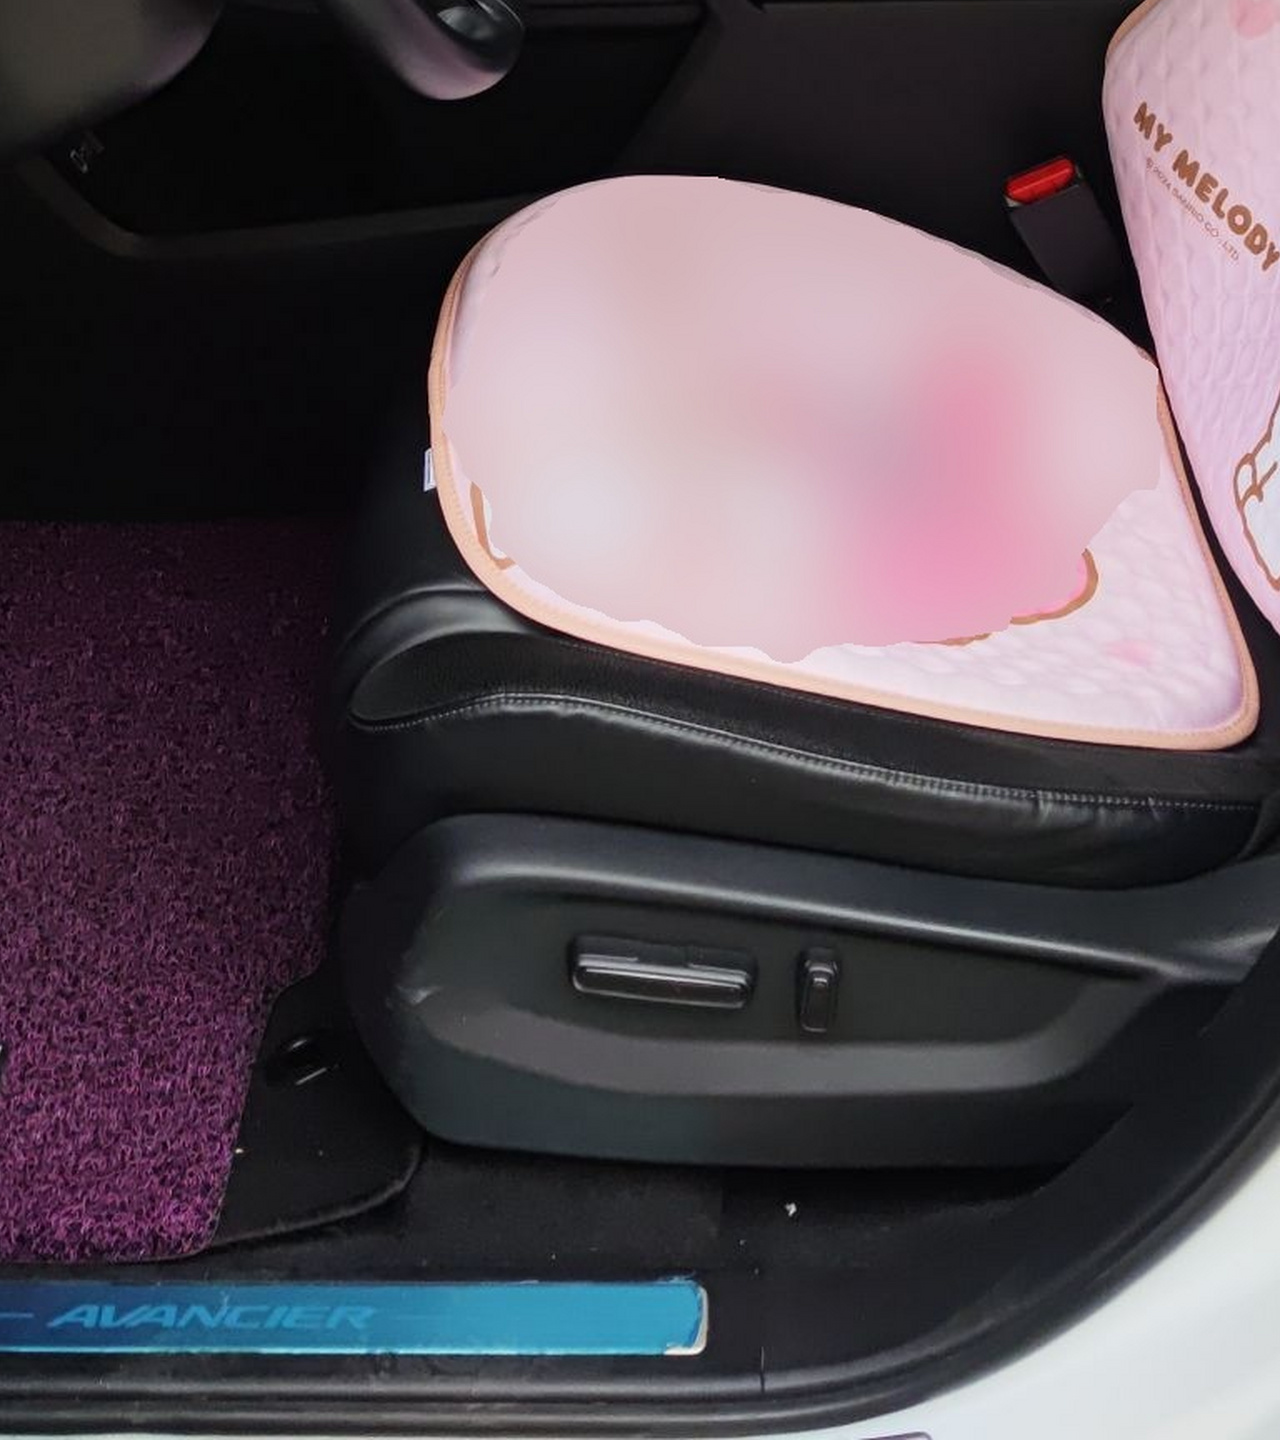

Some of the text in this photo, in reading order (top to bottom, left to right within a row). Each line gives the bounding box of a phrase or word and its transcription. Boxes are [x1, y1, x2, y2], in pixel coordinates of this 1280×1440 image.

[1134, 101, 1280, 271] MY MELODY
[46, 1305, 376, 1329] AVANCIER
